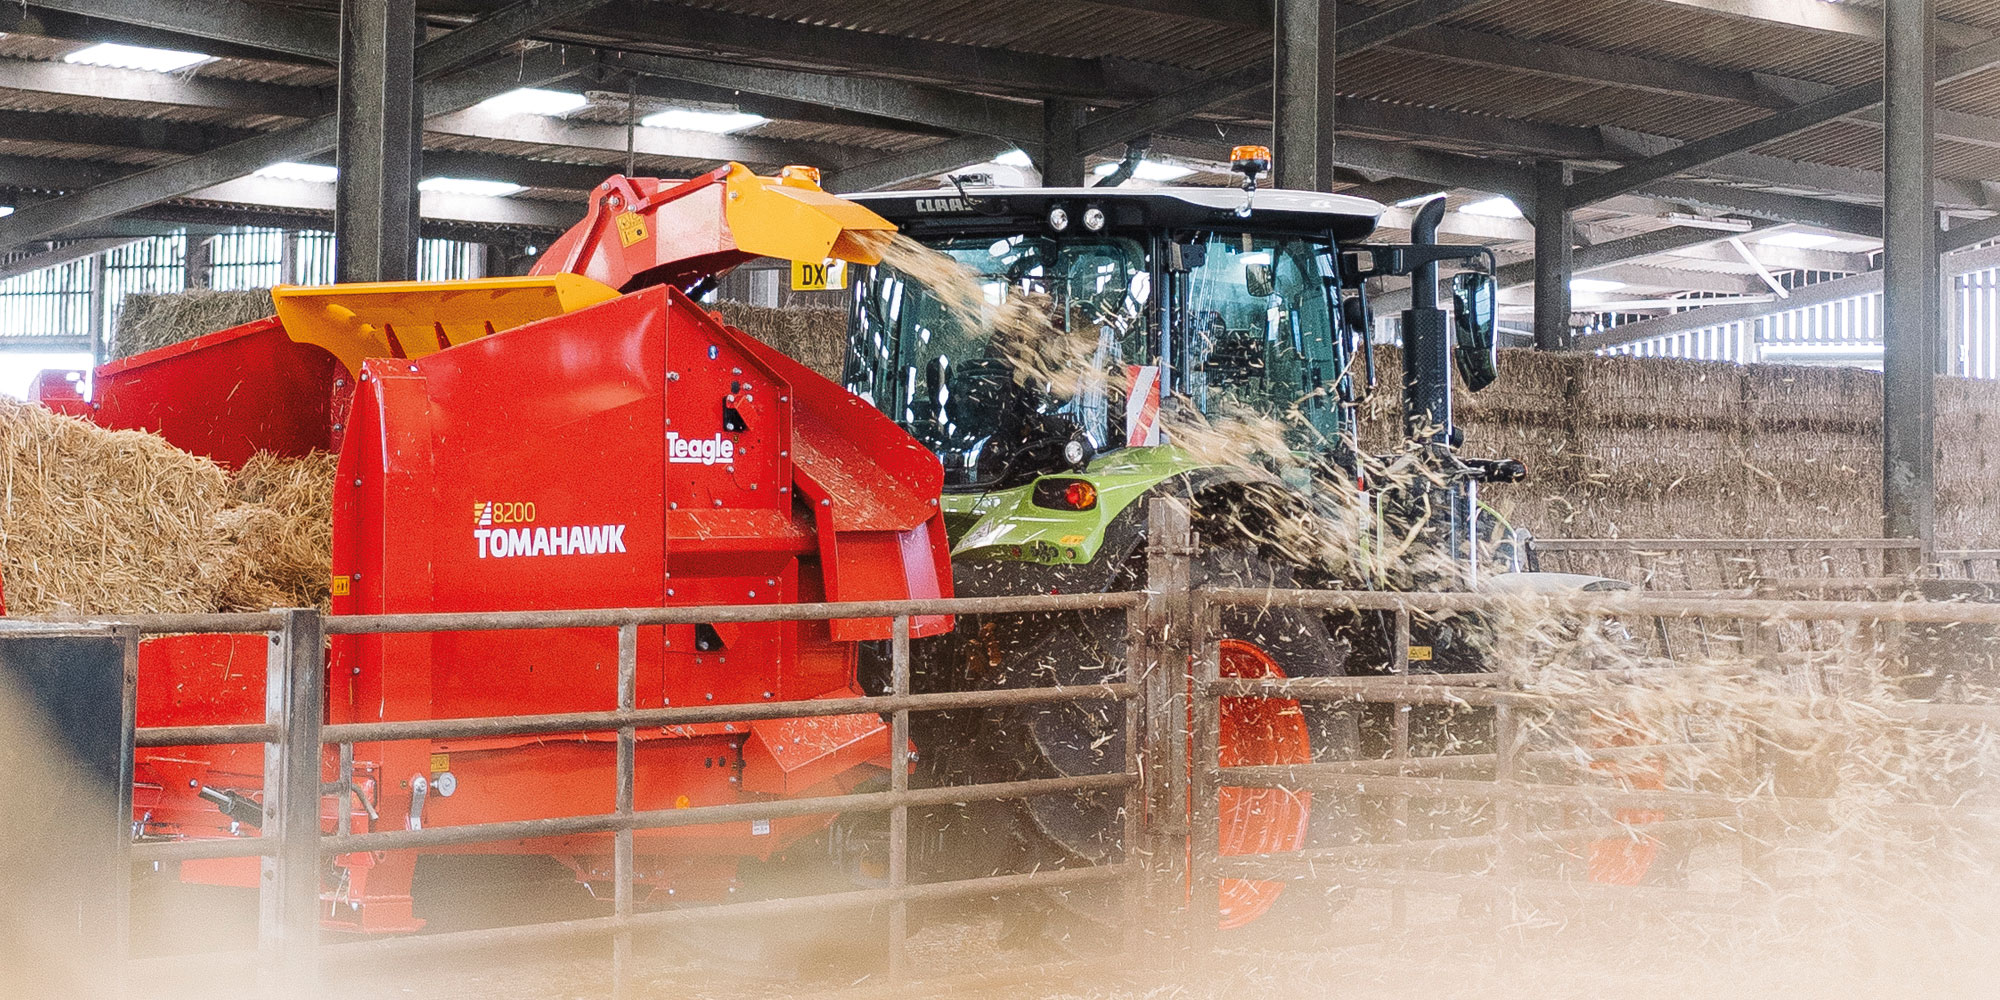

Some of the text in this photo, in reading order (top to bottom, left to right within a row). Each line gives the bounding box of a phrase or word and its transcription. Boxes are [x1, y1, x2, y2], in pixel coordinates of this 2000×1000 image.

[666, 431, 734, 466] Teagle
[492, 501, 536, 523] 8200
[473, 524, 627, 559] TOMAHAWK
